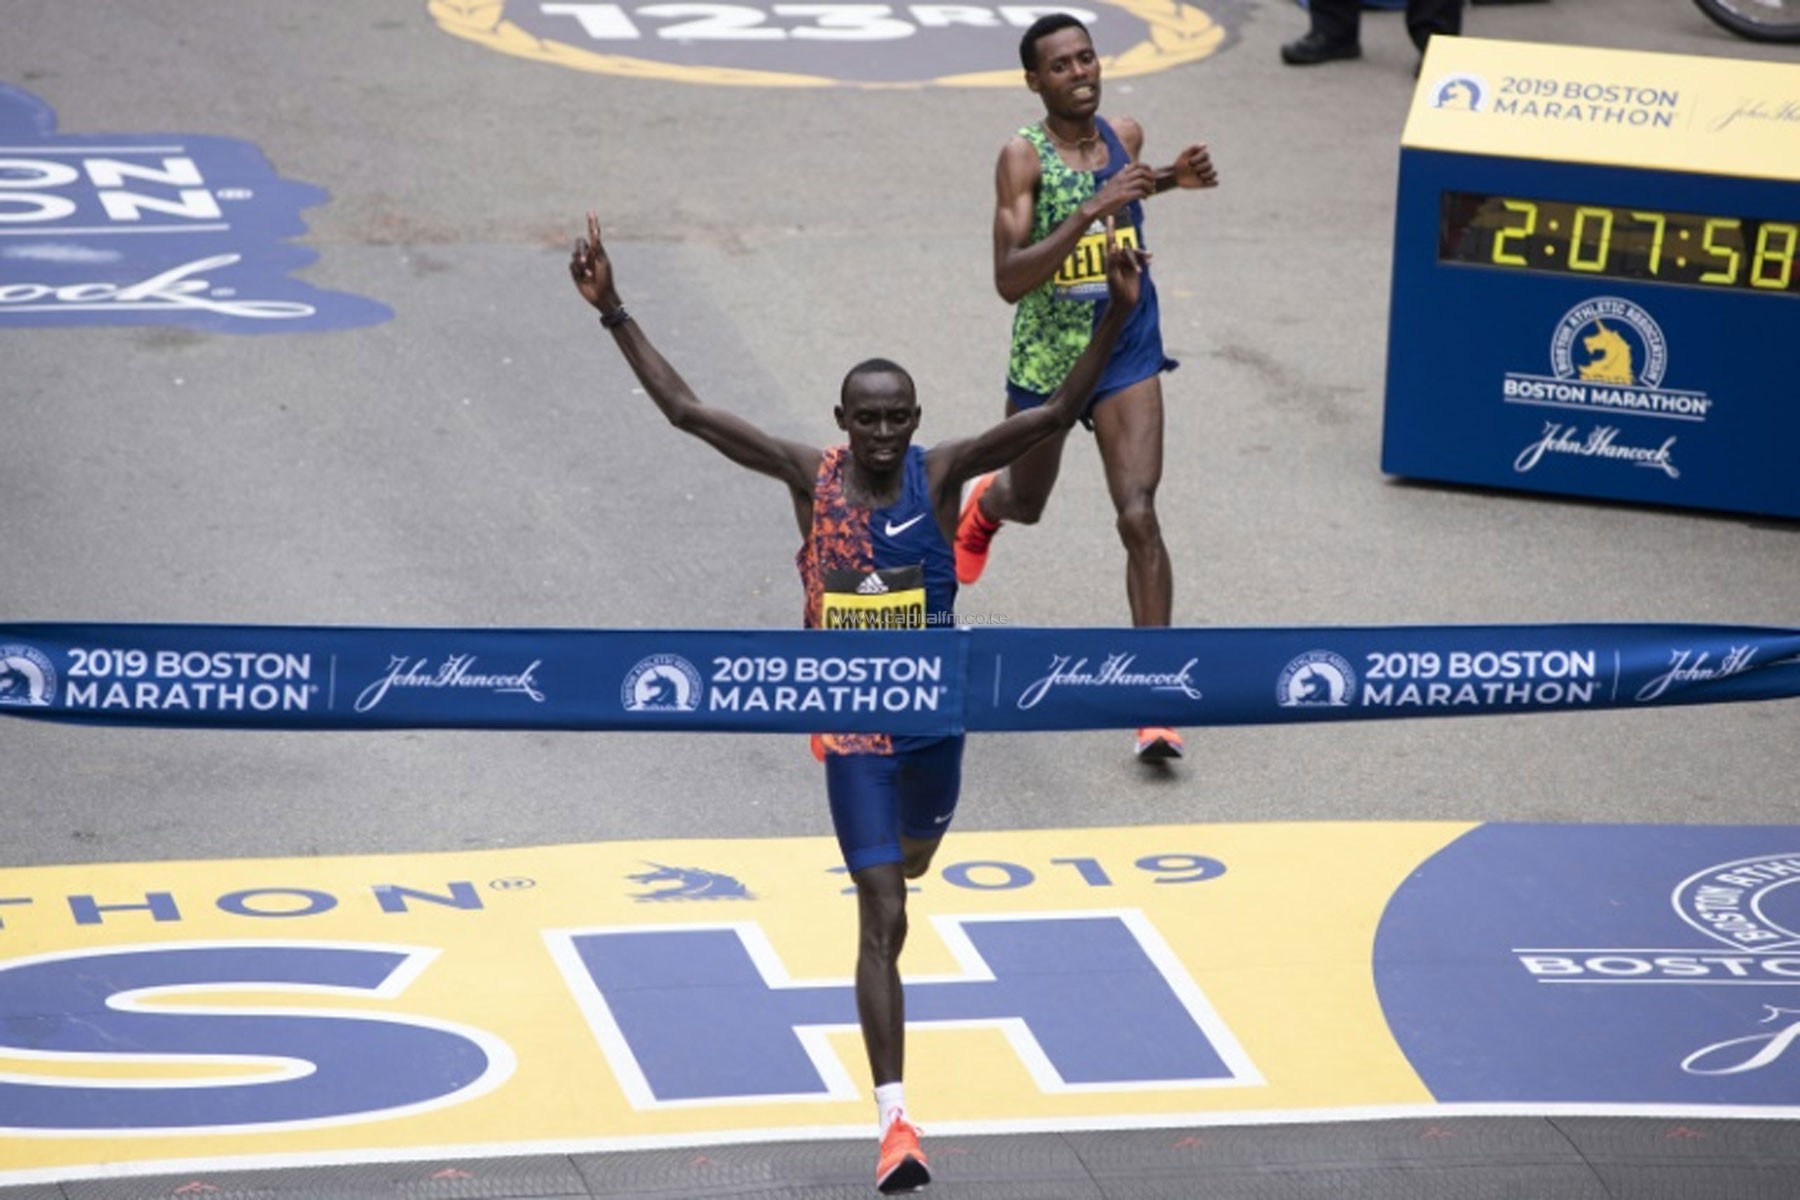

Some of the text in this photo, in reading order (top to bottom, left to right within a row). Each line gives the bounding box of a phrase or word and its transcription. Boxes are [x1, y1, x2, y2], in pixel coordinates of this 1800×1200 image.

[540, 3, 1098, 41] 123RD
[1500, 76, 1679, 108] 2019 BOSTON
[1493, 97, 1673, 128] MARATHON
[1492, 200, 1799, 288] 2:07:58
[1503, 378, 1708, 415] BOSTON MARATHON
[1513, 420, 1679, 479] John Hancock
[67, 648, 147, 677] 2019
[155, 651, 311, 680] BOSTON
[712, 657, 788, 682] 2019
[794, 657, 941, 682] BOSTON
[1366, 651, 1440, 679] 2019
[1448, 651, 1596, 678] BOSTON
[1635, 649, 1717, 701] John
[65, 682, 310, 711] MARATHON
[354, 653, 546, 712] John Hancock
[1017, 652, 1202, 709] John Hancock
[1361, 682, 1595, 706] MARATHON
[709, 686, 941, 711] MARATHON
